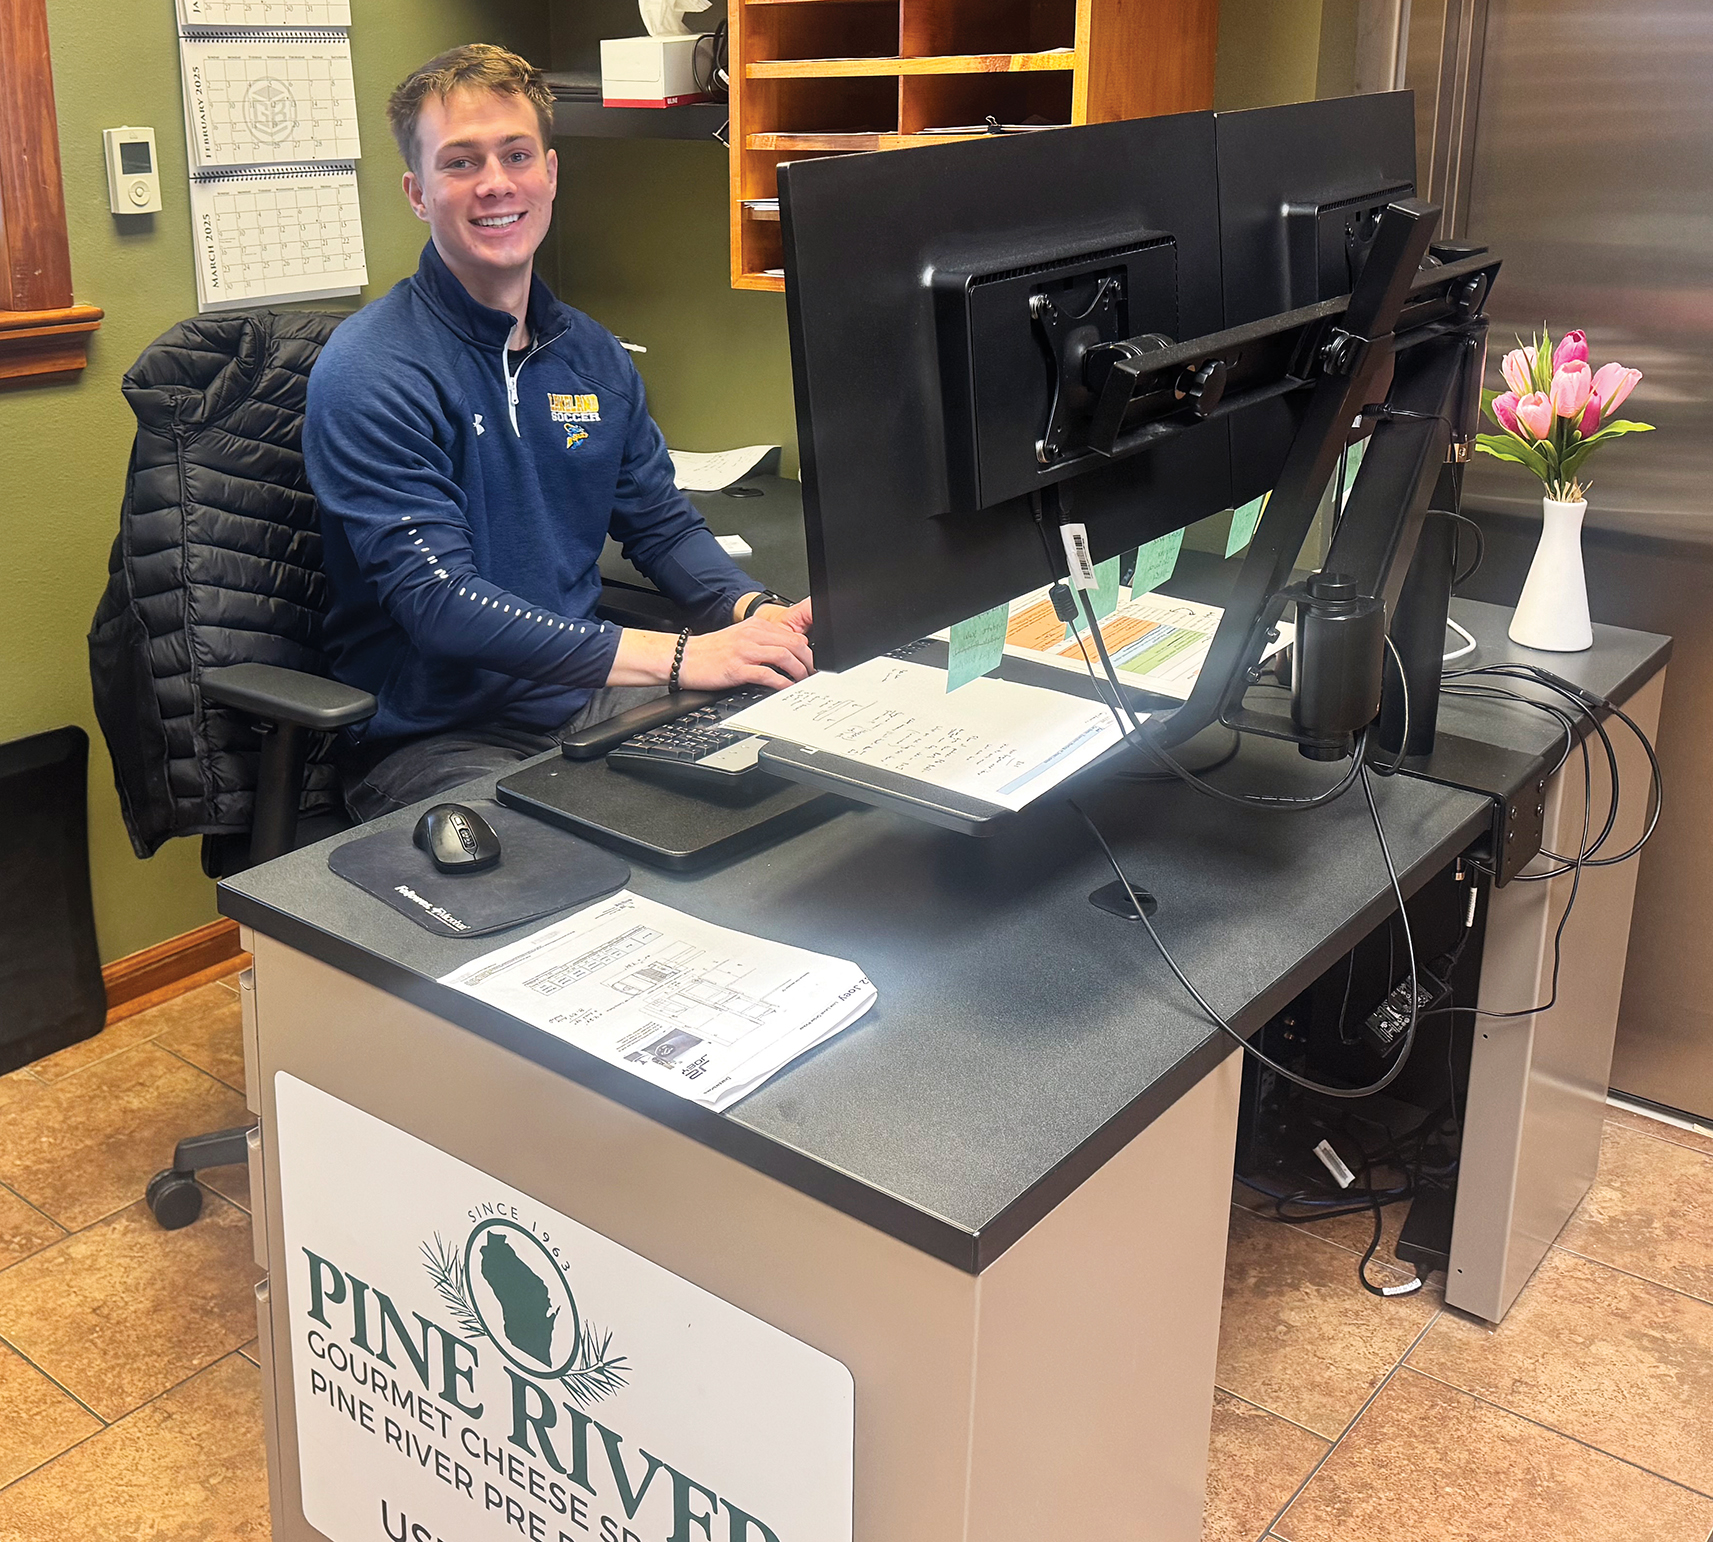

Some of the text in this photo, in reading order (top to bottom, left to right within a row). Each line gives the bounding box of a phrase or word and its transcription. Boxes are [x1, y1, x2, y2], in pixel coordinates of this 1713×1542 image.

[193, 66, 212, 158] FEBRUARY 2025
[202, 213, 219, 288] MARCH 2025
[551, 411, 602, 422] SOCCER
[467, 1201, 571, 1272] SINCE 1963
[301, 1246, 484, 1420] PINE
[307, 1330, 453, 1439] GOURMET
[461, 1427, 589, 1532] CHEESE
[311, 1368, 547, 1542] PINE RIVER PRE
